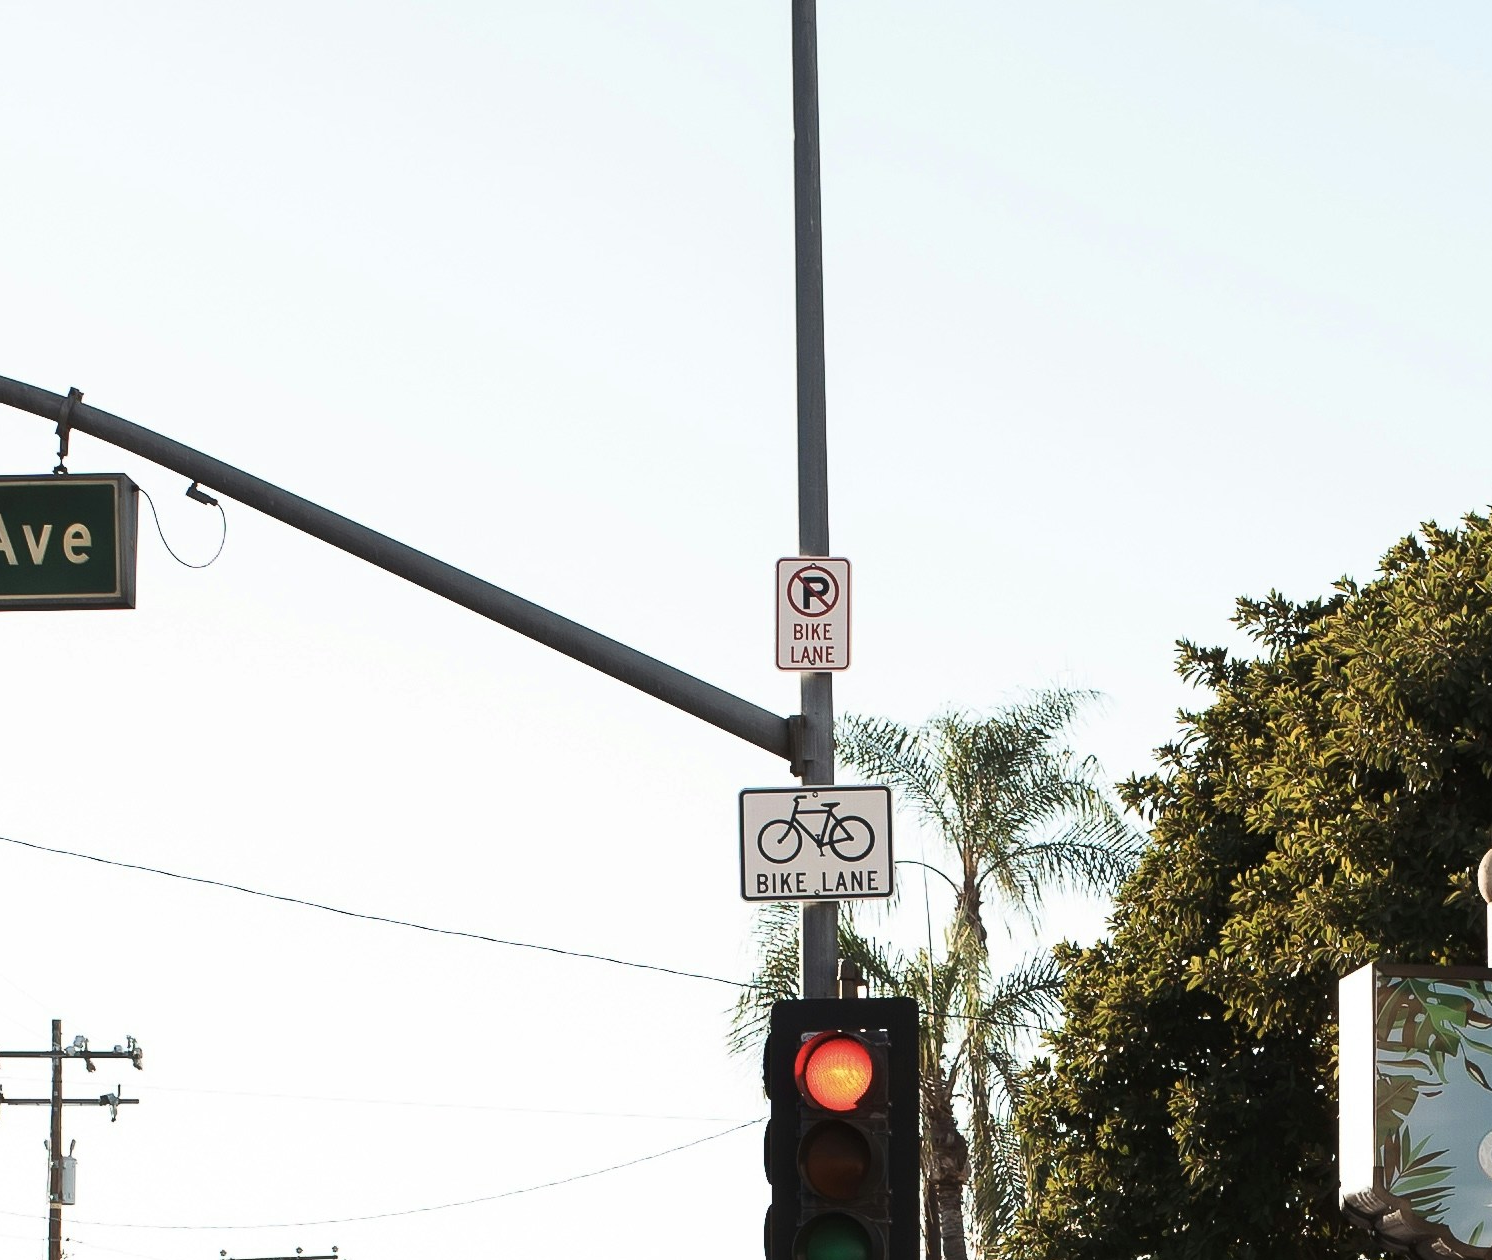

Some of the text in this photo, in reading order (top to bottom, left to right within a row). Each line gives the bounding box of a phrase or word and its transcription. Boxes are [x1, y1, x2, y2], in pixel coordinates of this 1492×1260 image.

[793, 623, 833, 641] BIKE
[791, 646, 835, 664] LANE
[756, 870, 879, 894] BIKE LANE
